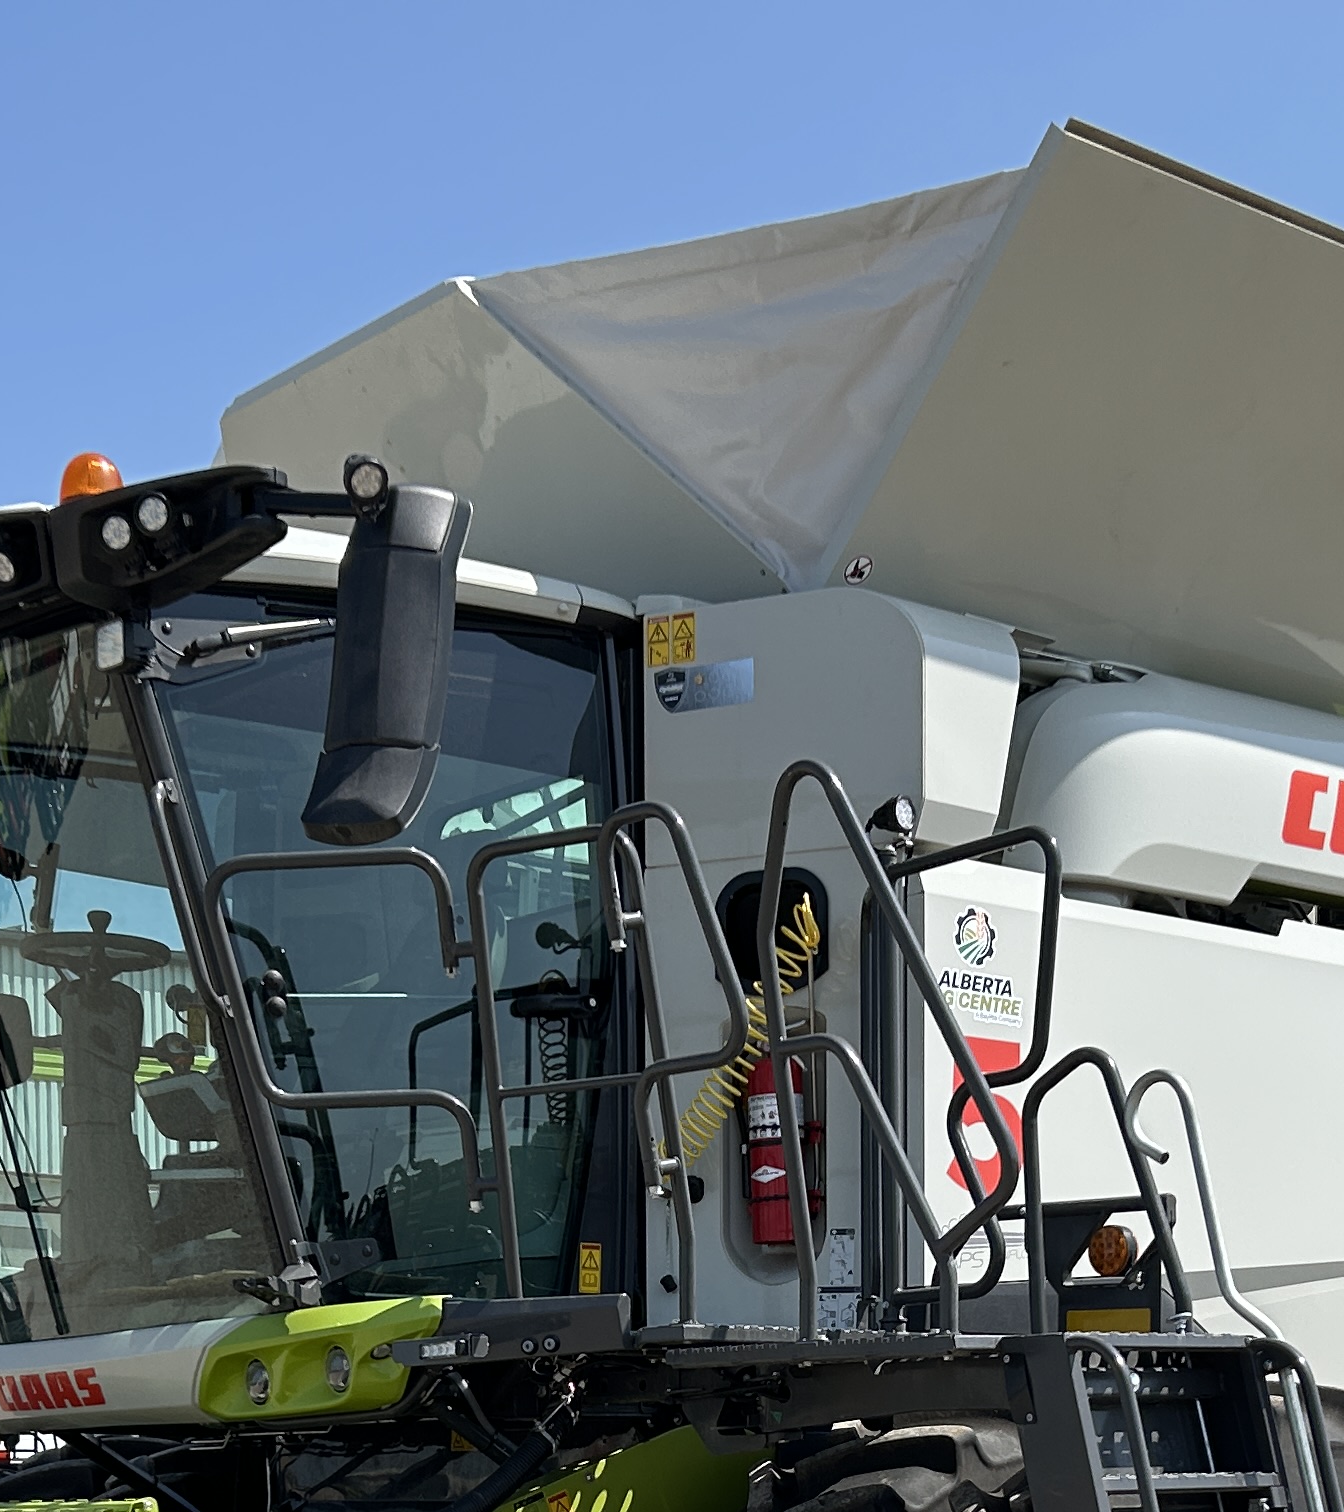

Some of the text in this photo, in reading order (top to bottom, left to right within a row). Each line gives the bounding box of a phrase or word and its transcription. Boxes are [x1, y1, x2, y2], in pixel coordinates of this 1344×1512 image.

[939, 970, 1013, 997] ALBERTA
[943, 989, 1021, 1016] G CENTRE
